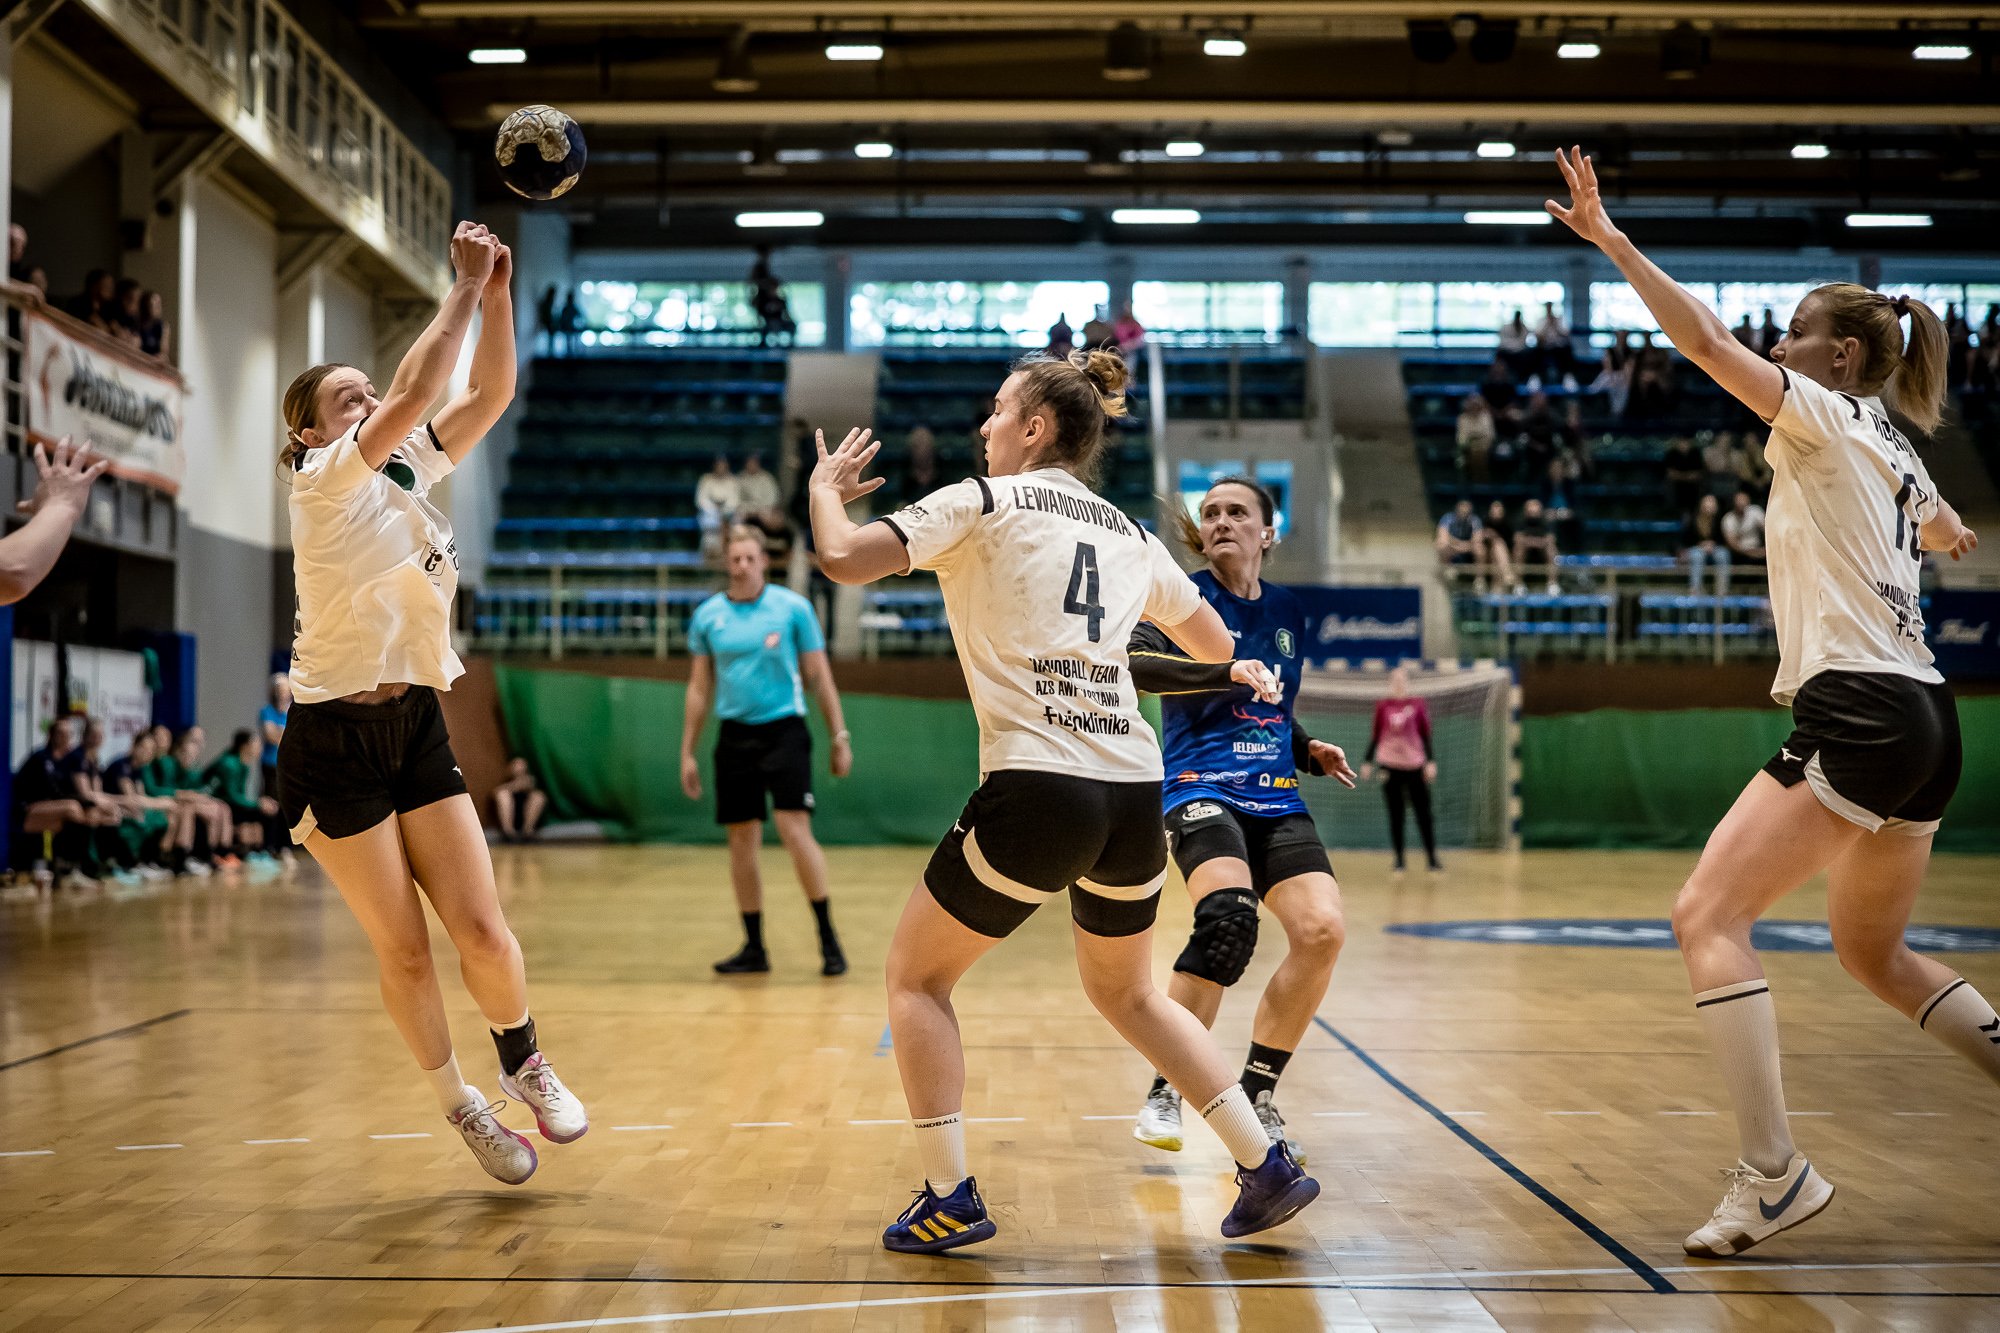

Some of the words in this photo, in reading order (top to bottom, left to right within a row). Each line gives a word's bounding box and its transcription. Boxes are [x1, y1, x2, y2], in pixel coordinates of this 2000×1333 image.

[1012, 485, 1132, 537] LEWANDOWSKA
[1063, 540, 1105, 643] 4
[1035, 680, 1055, 696] AZS
[1089, 664, 1119, 684] TEAM
